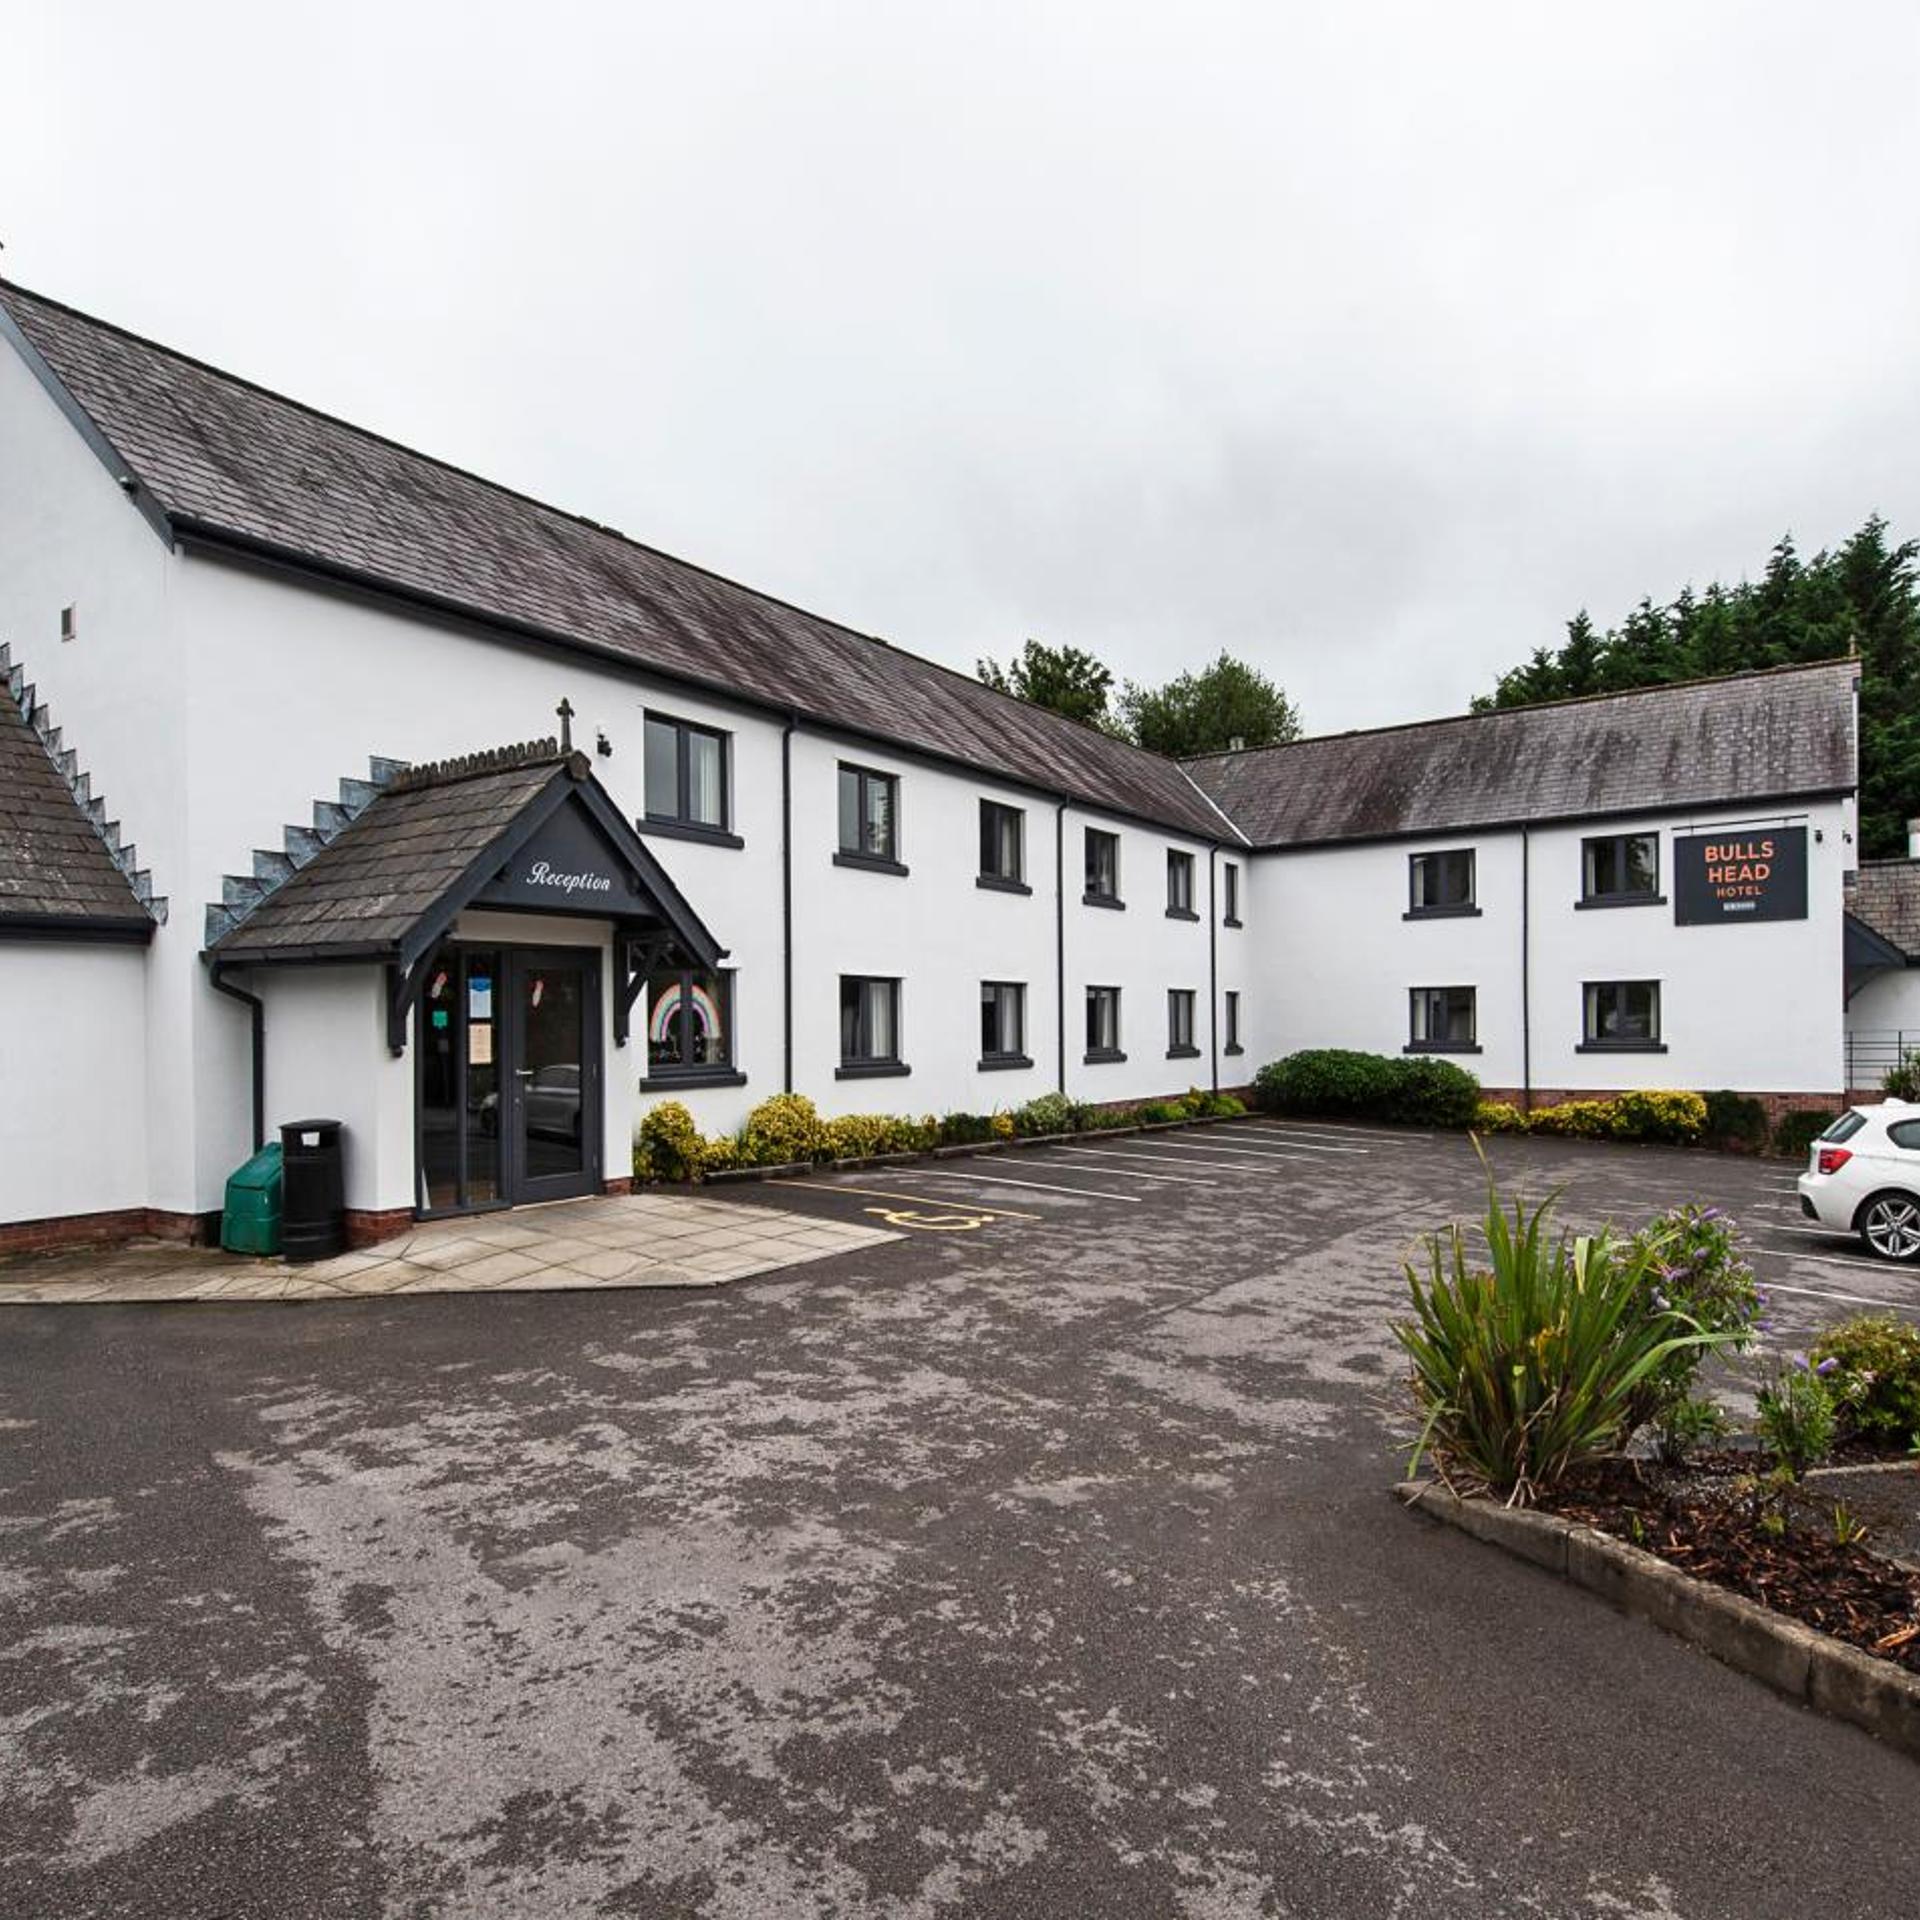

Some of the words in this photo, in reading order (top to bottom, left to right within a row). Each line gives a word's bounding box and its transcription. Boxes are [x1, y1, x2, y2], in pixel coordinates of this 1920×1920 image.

[1704, 841, 1775, 863] BULLS
[526, 862, 611, 893] Reception
[1708, 864, 1771, 883] HEAD
[1716, 886, 1763, 898] HOTEL
